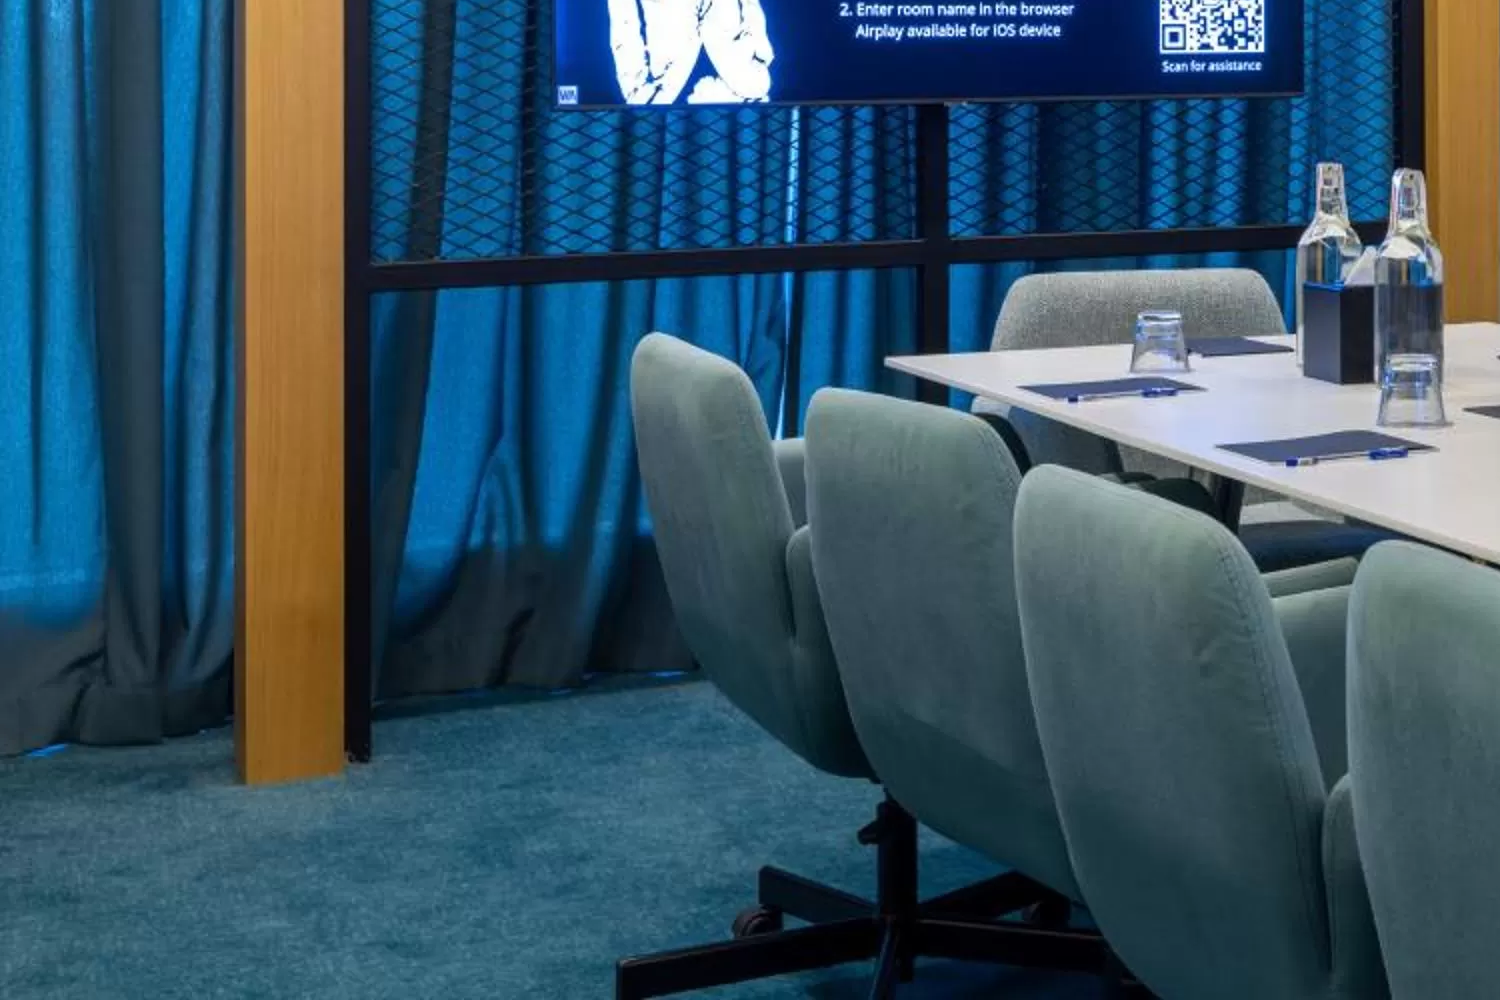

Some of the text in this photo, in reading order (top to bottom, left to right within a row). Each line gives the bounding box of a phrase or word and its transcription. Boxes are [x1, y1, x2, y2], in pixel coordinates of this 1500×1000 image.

[839, 2, 1075, 16] 2. Enter room name in the browser
[855, 24, 905, 41] Airplay
[906, 23, 968, 37] available
[969, 23, 991, 37] for
[1018, 23, 1061, 37] device
[1162, 59, 1263, 73] Scan for assistance
